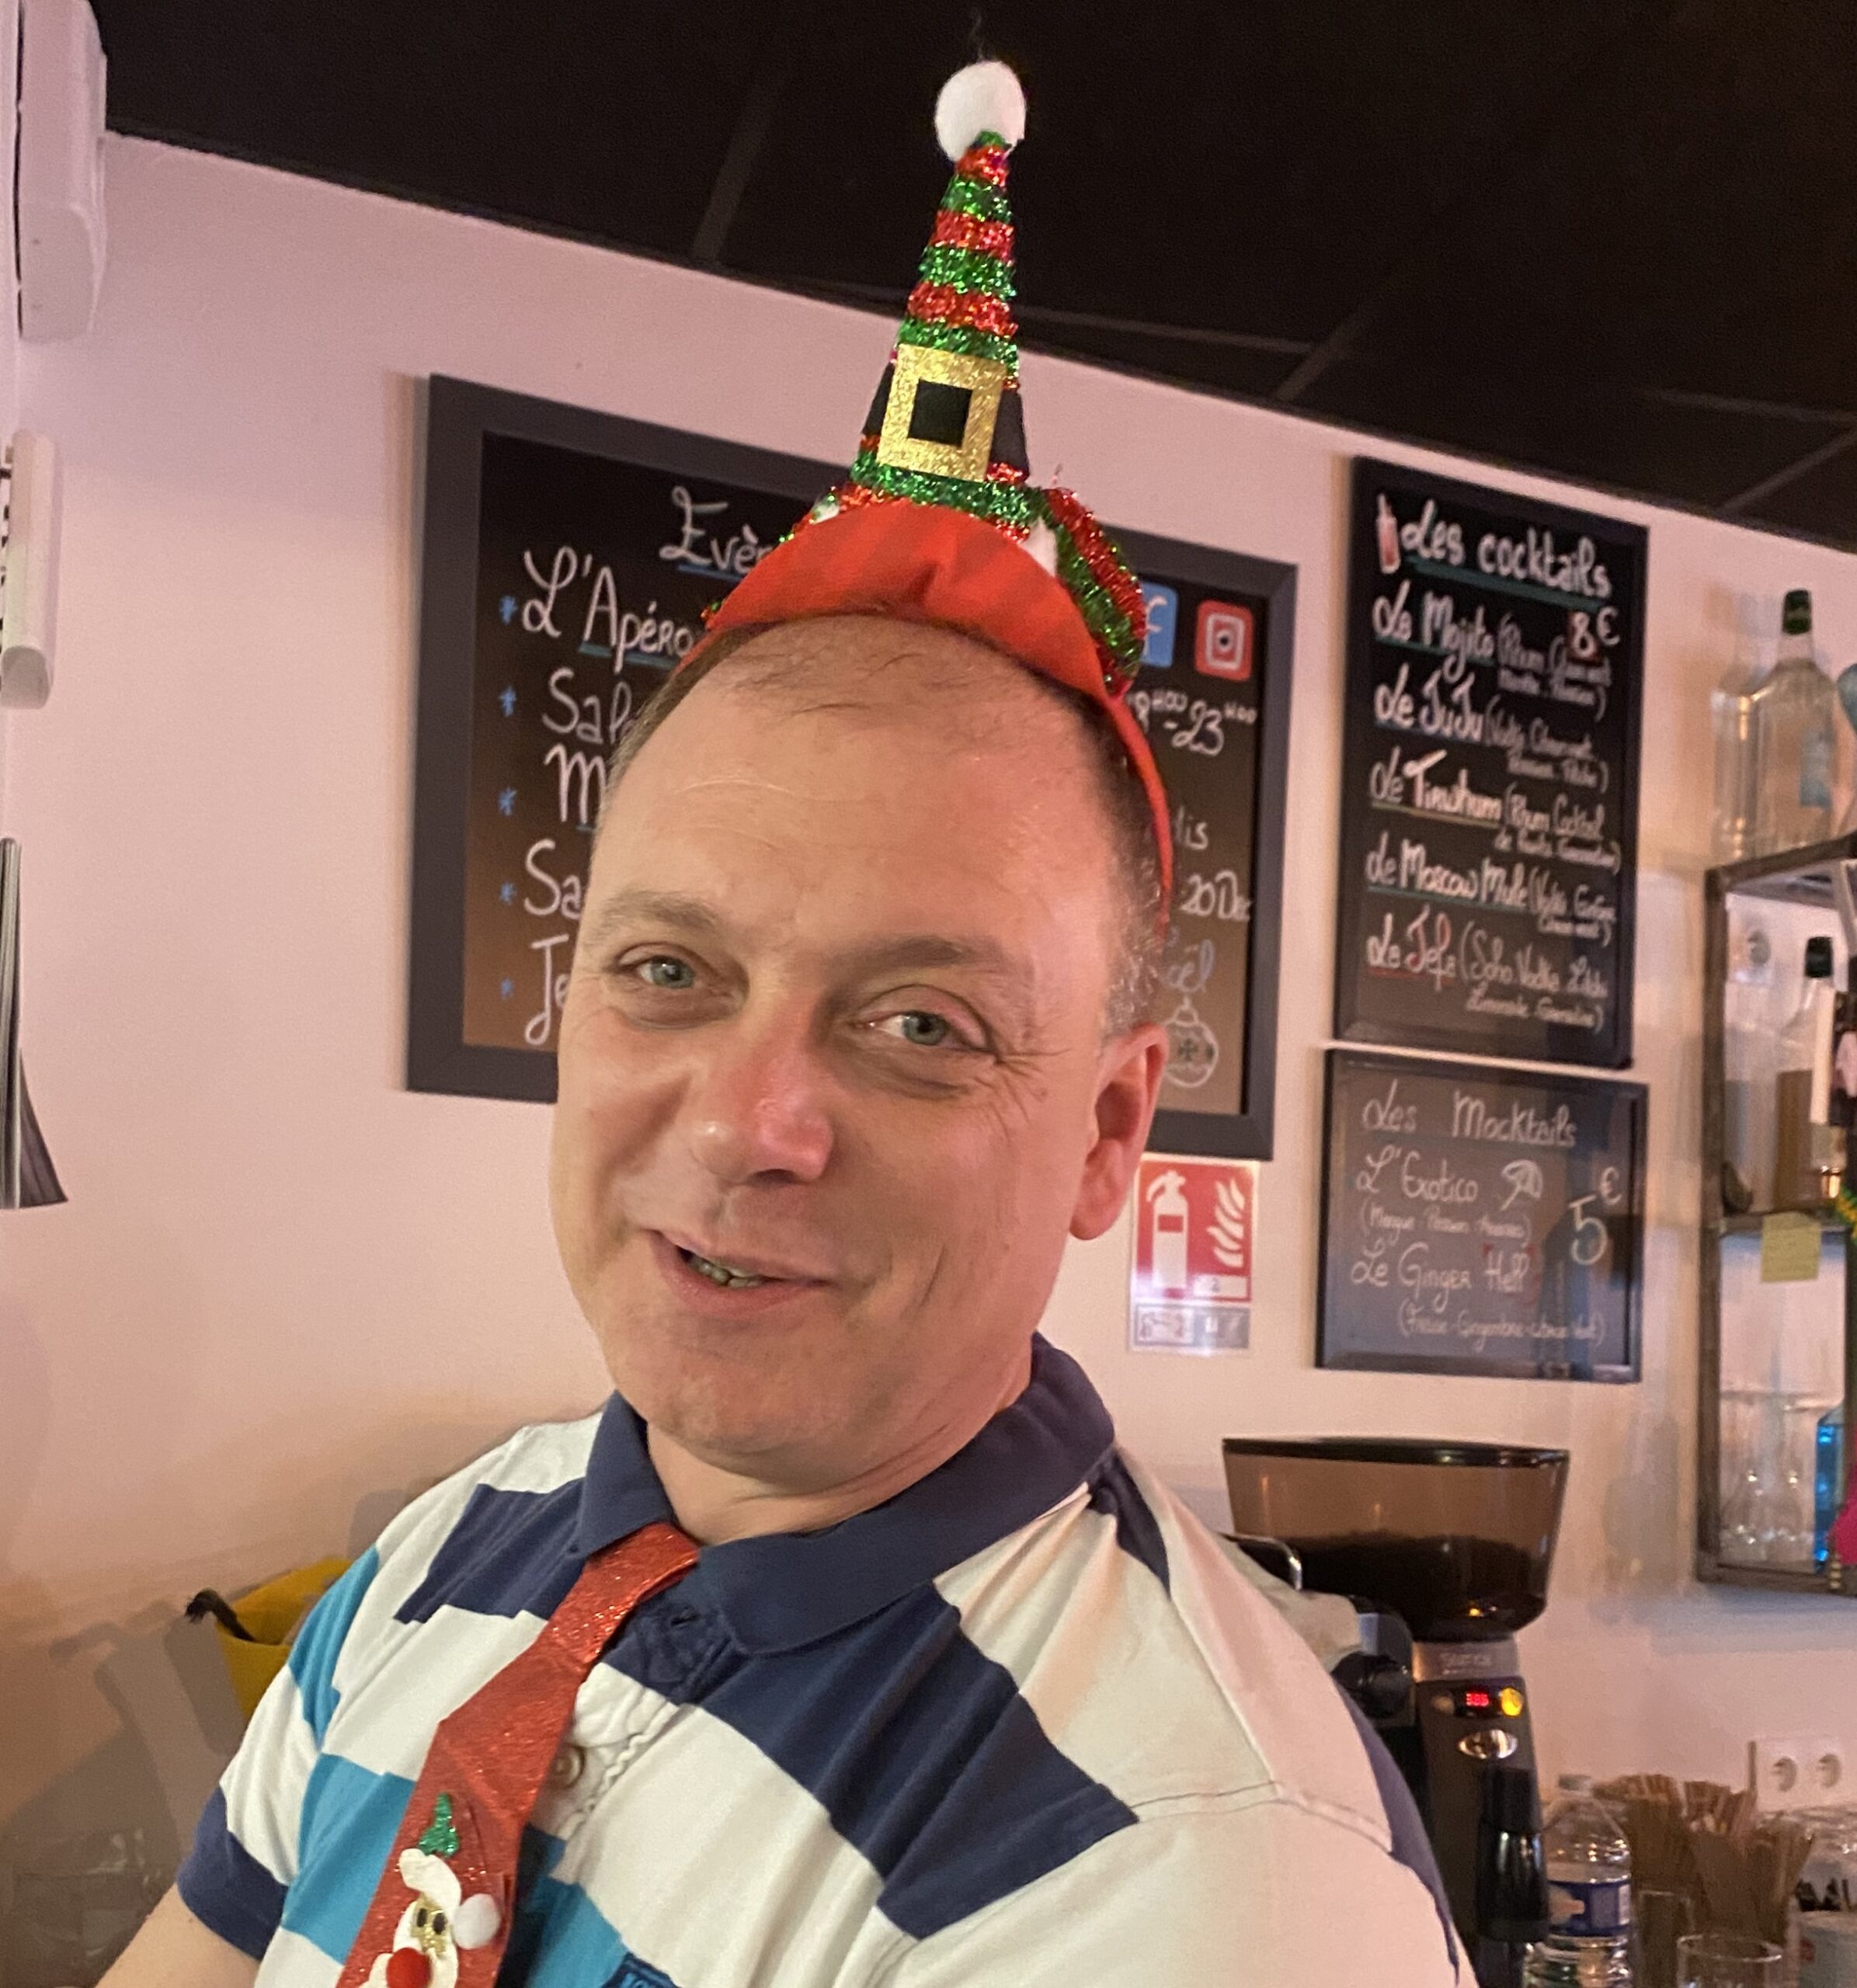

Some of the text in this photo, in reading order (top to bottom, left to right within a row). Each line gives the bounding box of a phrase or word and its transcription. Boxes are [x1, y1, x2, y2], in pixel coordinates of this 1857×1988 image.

[1400, 499, 1613, 600] Les cocktails
[1372, 579, 1414, 644] Le
[1421, 590, 1497, 683] Mojito
[1374, 662, 1415, 727] Le
[1420, 669, 1484, 743] JuJu
[1370, 746, 1404, 804] Le
[1365, 831, 1397, 885] Le
[1399, 838, 1479, 900] Moscow
[1480, 856, 1528, 908] Mule
[1366, 912, 1401, 969] Le
[1403, 902, 1458, 992] Jefe
[1361, 1078, 1579, 1149] Les Mocktails
[1351, 1236, 1389, 1288] Le
[1483, 1248, 1532, 1294] Hell
